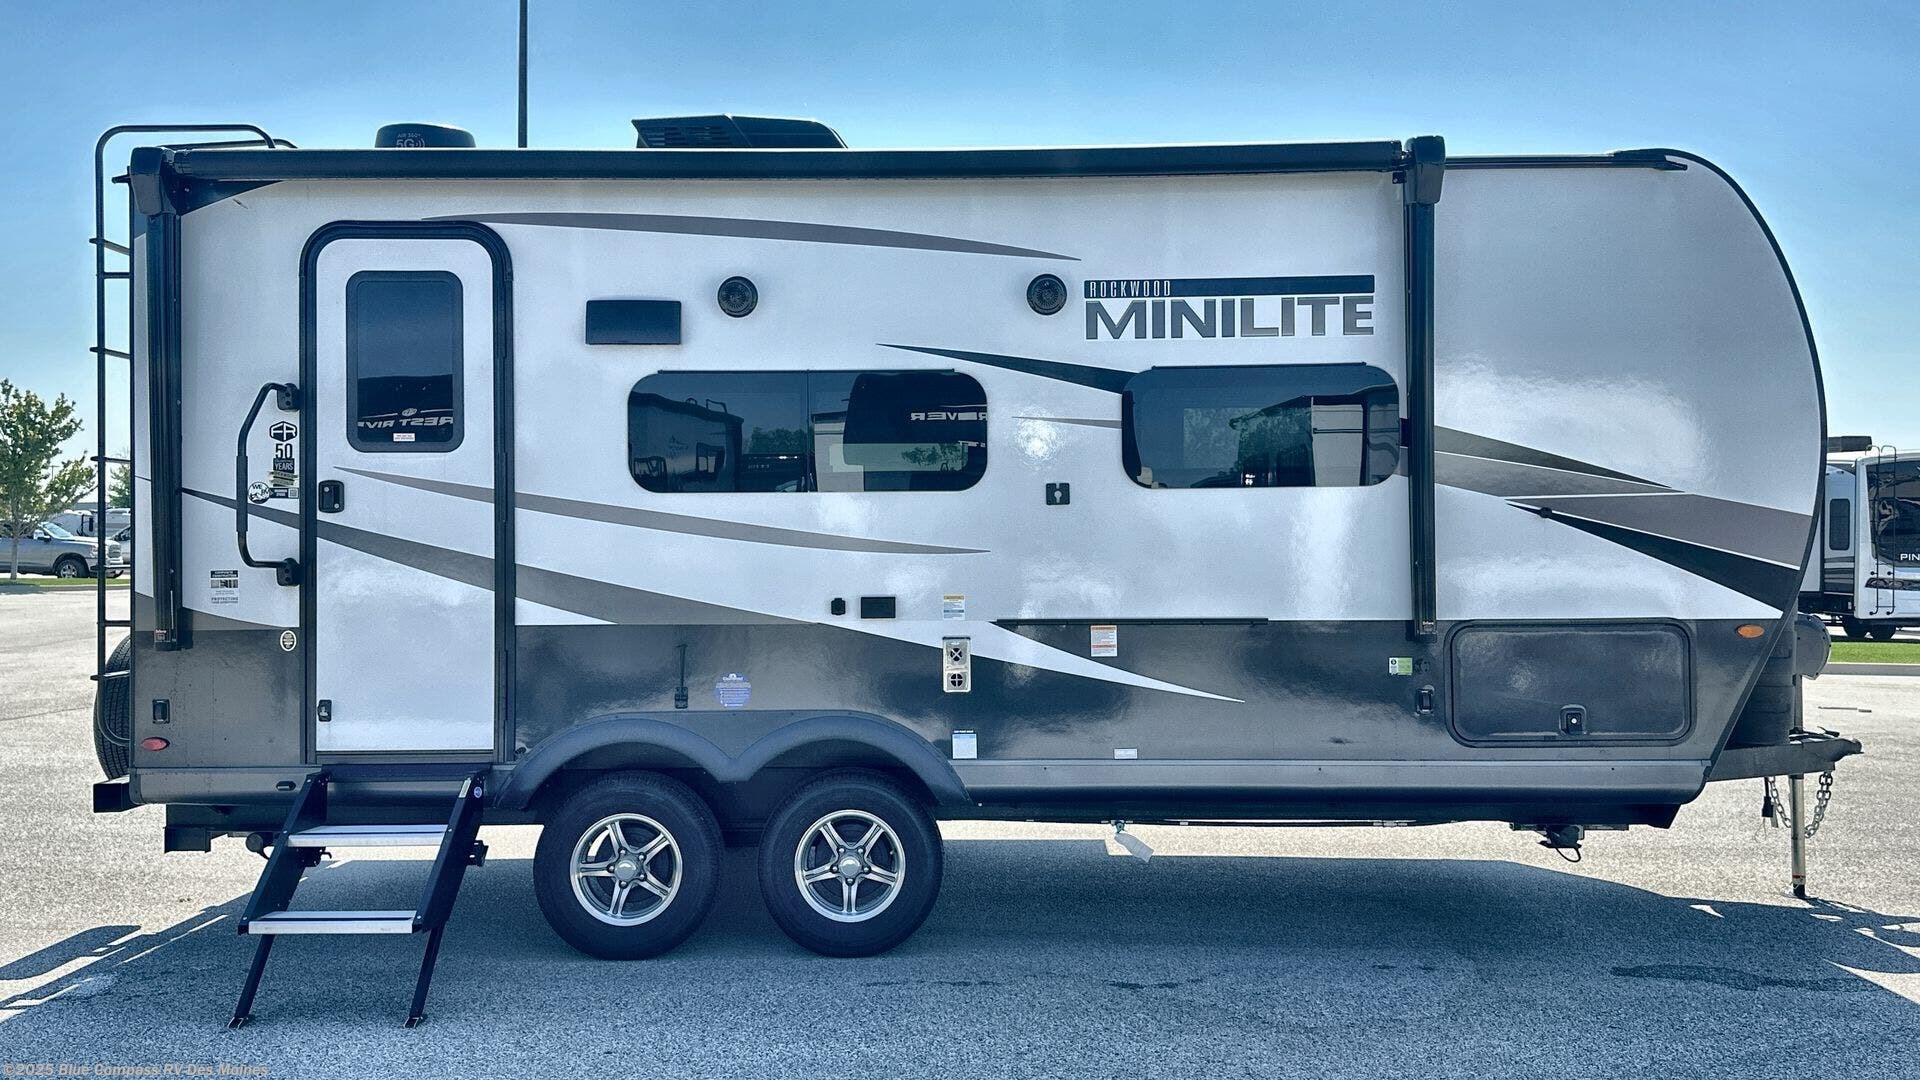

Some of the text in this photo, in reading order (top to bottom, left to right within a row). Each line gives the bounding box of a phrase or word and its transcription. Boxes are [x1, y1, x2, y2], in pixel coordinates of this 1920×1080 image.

[1089, 280, 1171, 297] ROCKWOOD
[1085, 296, 1374, 340] MINILITE
[275, 443, 293, 459] 50
[274, 461, 294, 471] YEARS
